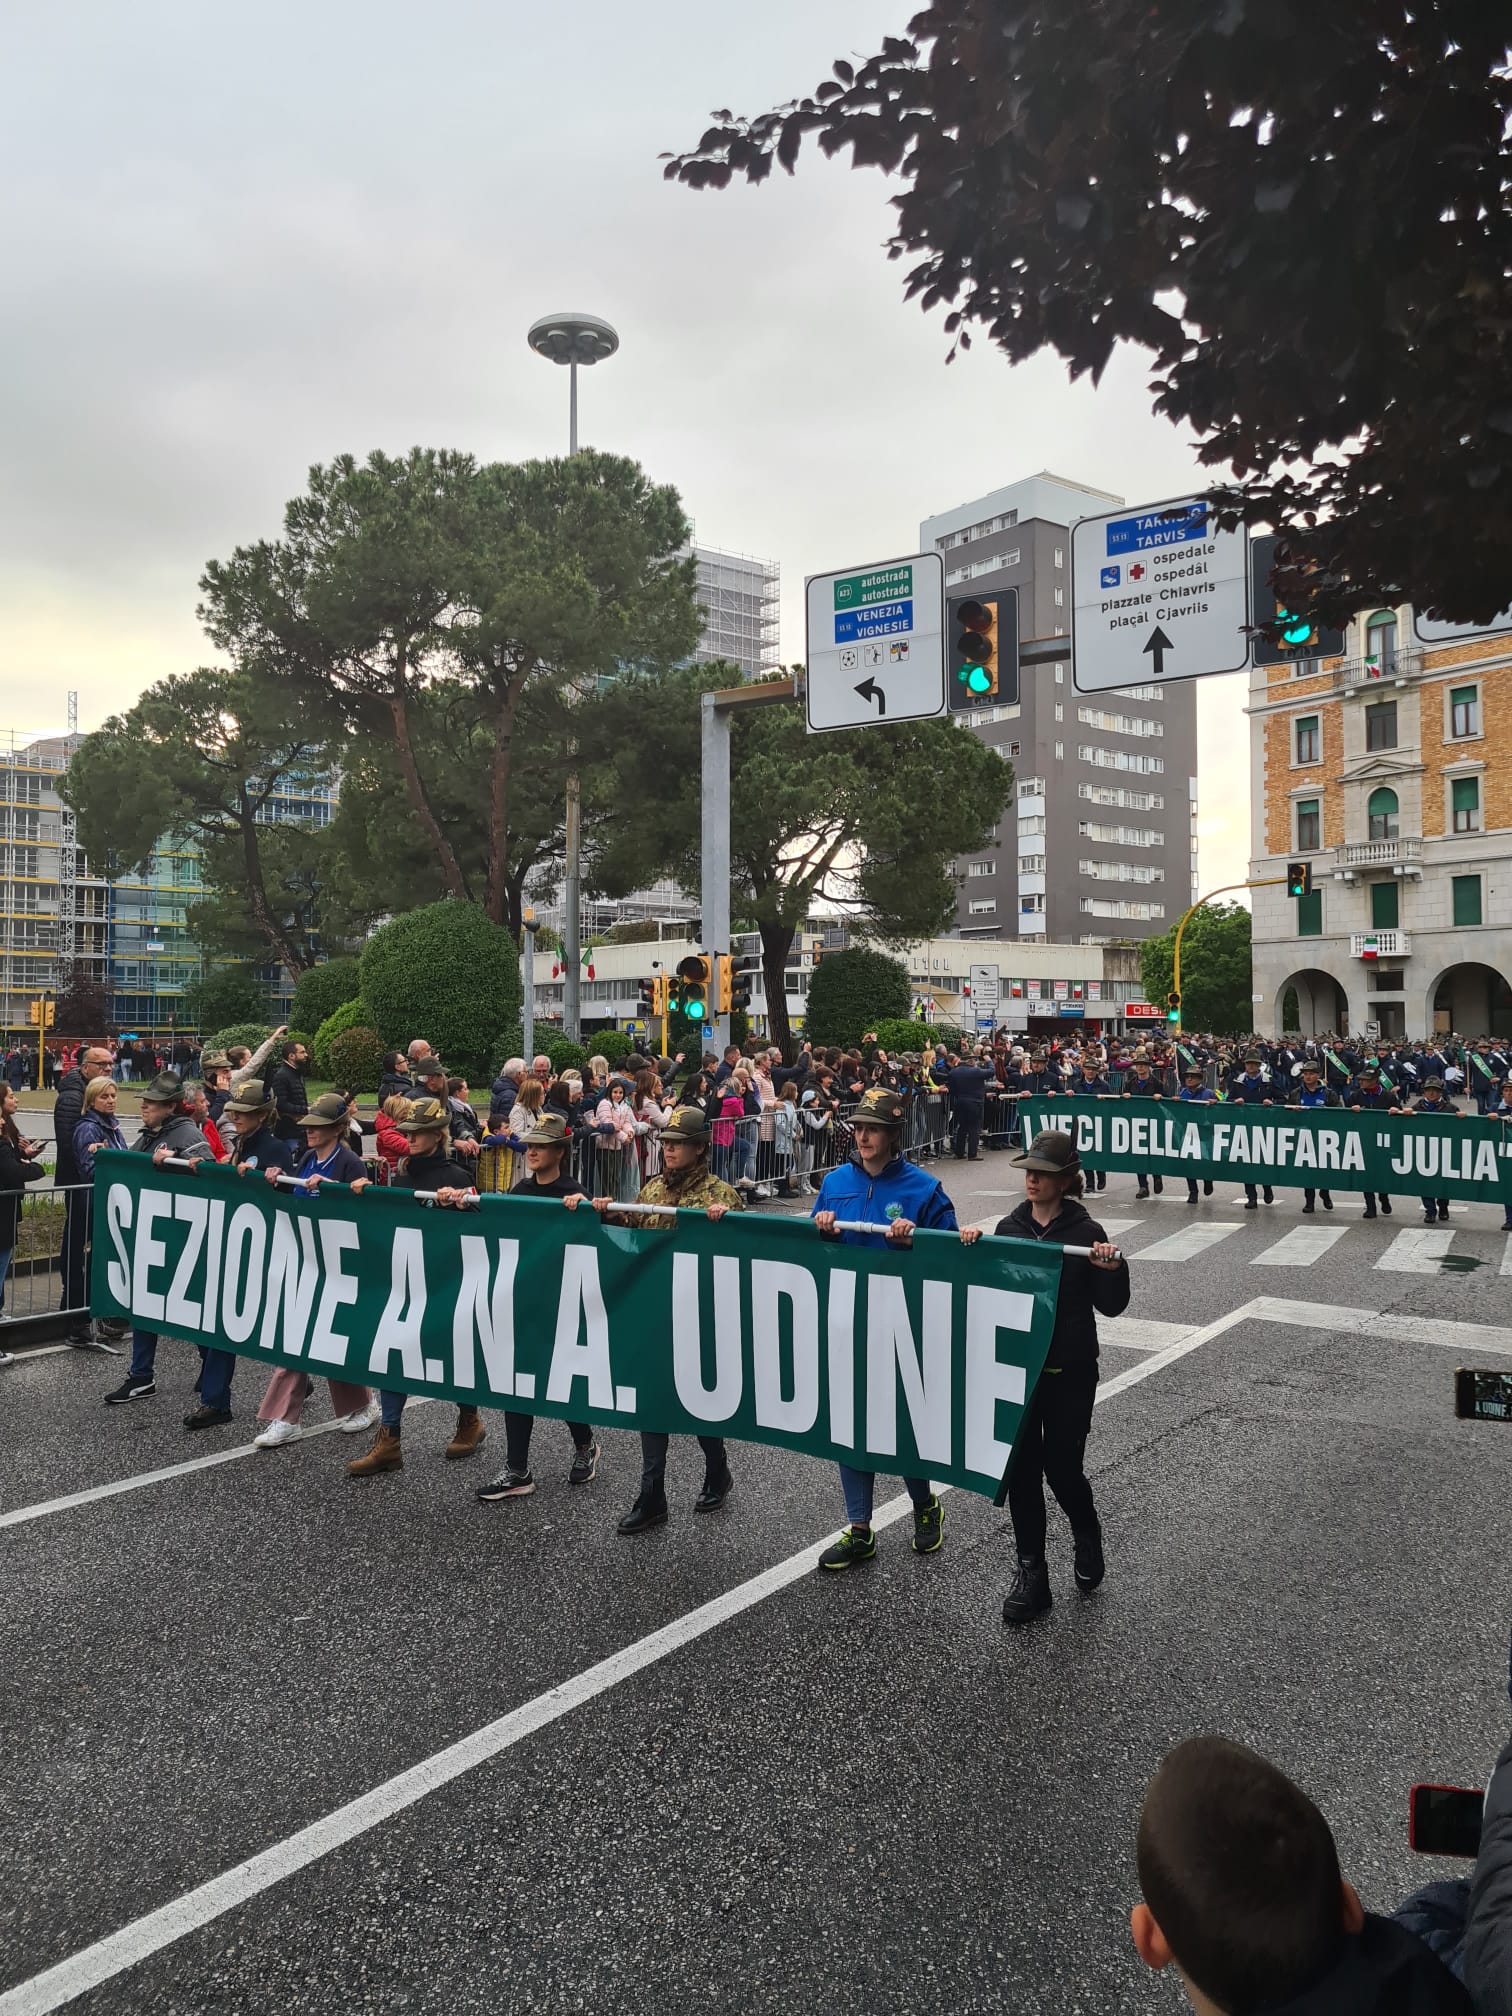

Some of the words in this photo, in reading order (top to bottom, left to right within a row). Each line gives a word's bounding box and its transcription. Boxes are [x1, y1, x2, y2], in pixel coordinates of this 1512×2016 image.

[1136, 529, 1186, 548] TARVIS
[1153, 544, 1216, 564] ospedale
[861, 569, 909, 587] autostrada
[1154, 562, 1208, 582] ospedâl
[862, 584, 909, 602] autostrade
[1101, 593, 1152, 613] piazzale
[1160, 582, 1216, 601] Chiavris
[856, 605, 904, 622] VENEZIA
[1110, 612, 1149, 630] plaçâl
[1156, 602, 1209, 620] Cjavriis
[857, 619, 910, 637] VIGNESIE
[1133, 1006, 1162, 1015] DES
[1023, 1115, 1033, 1150] I
[1111, 1117, 1202, 1160] DELLA
[1212, 1123, 1366, 1171] FANFARA
[1376, 1132, 1512, 1182] "JULIA"
[106, 1183, 361, 1366] SEZIONE
[368, 1226, 636, 1414] A.N.A.
[672, 1251, 1035, 1481] UDINE
